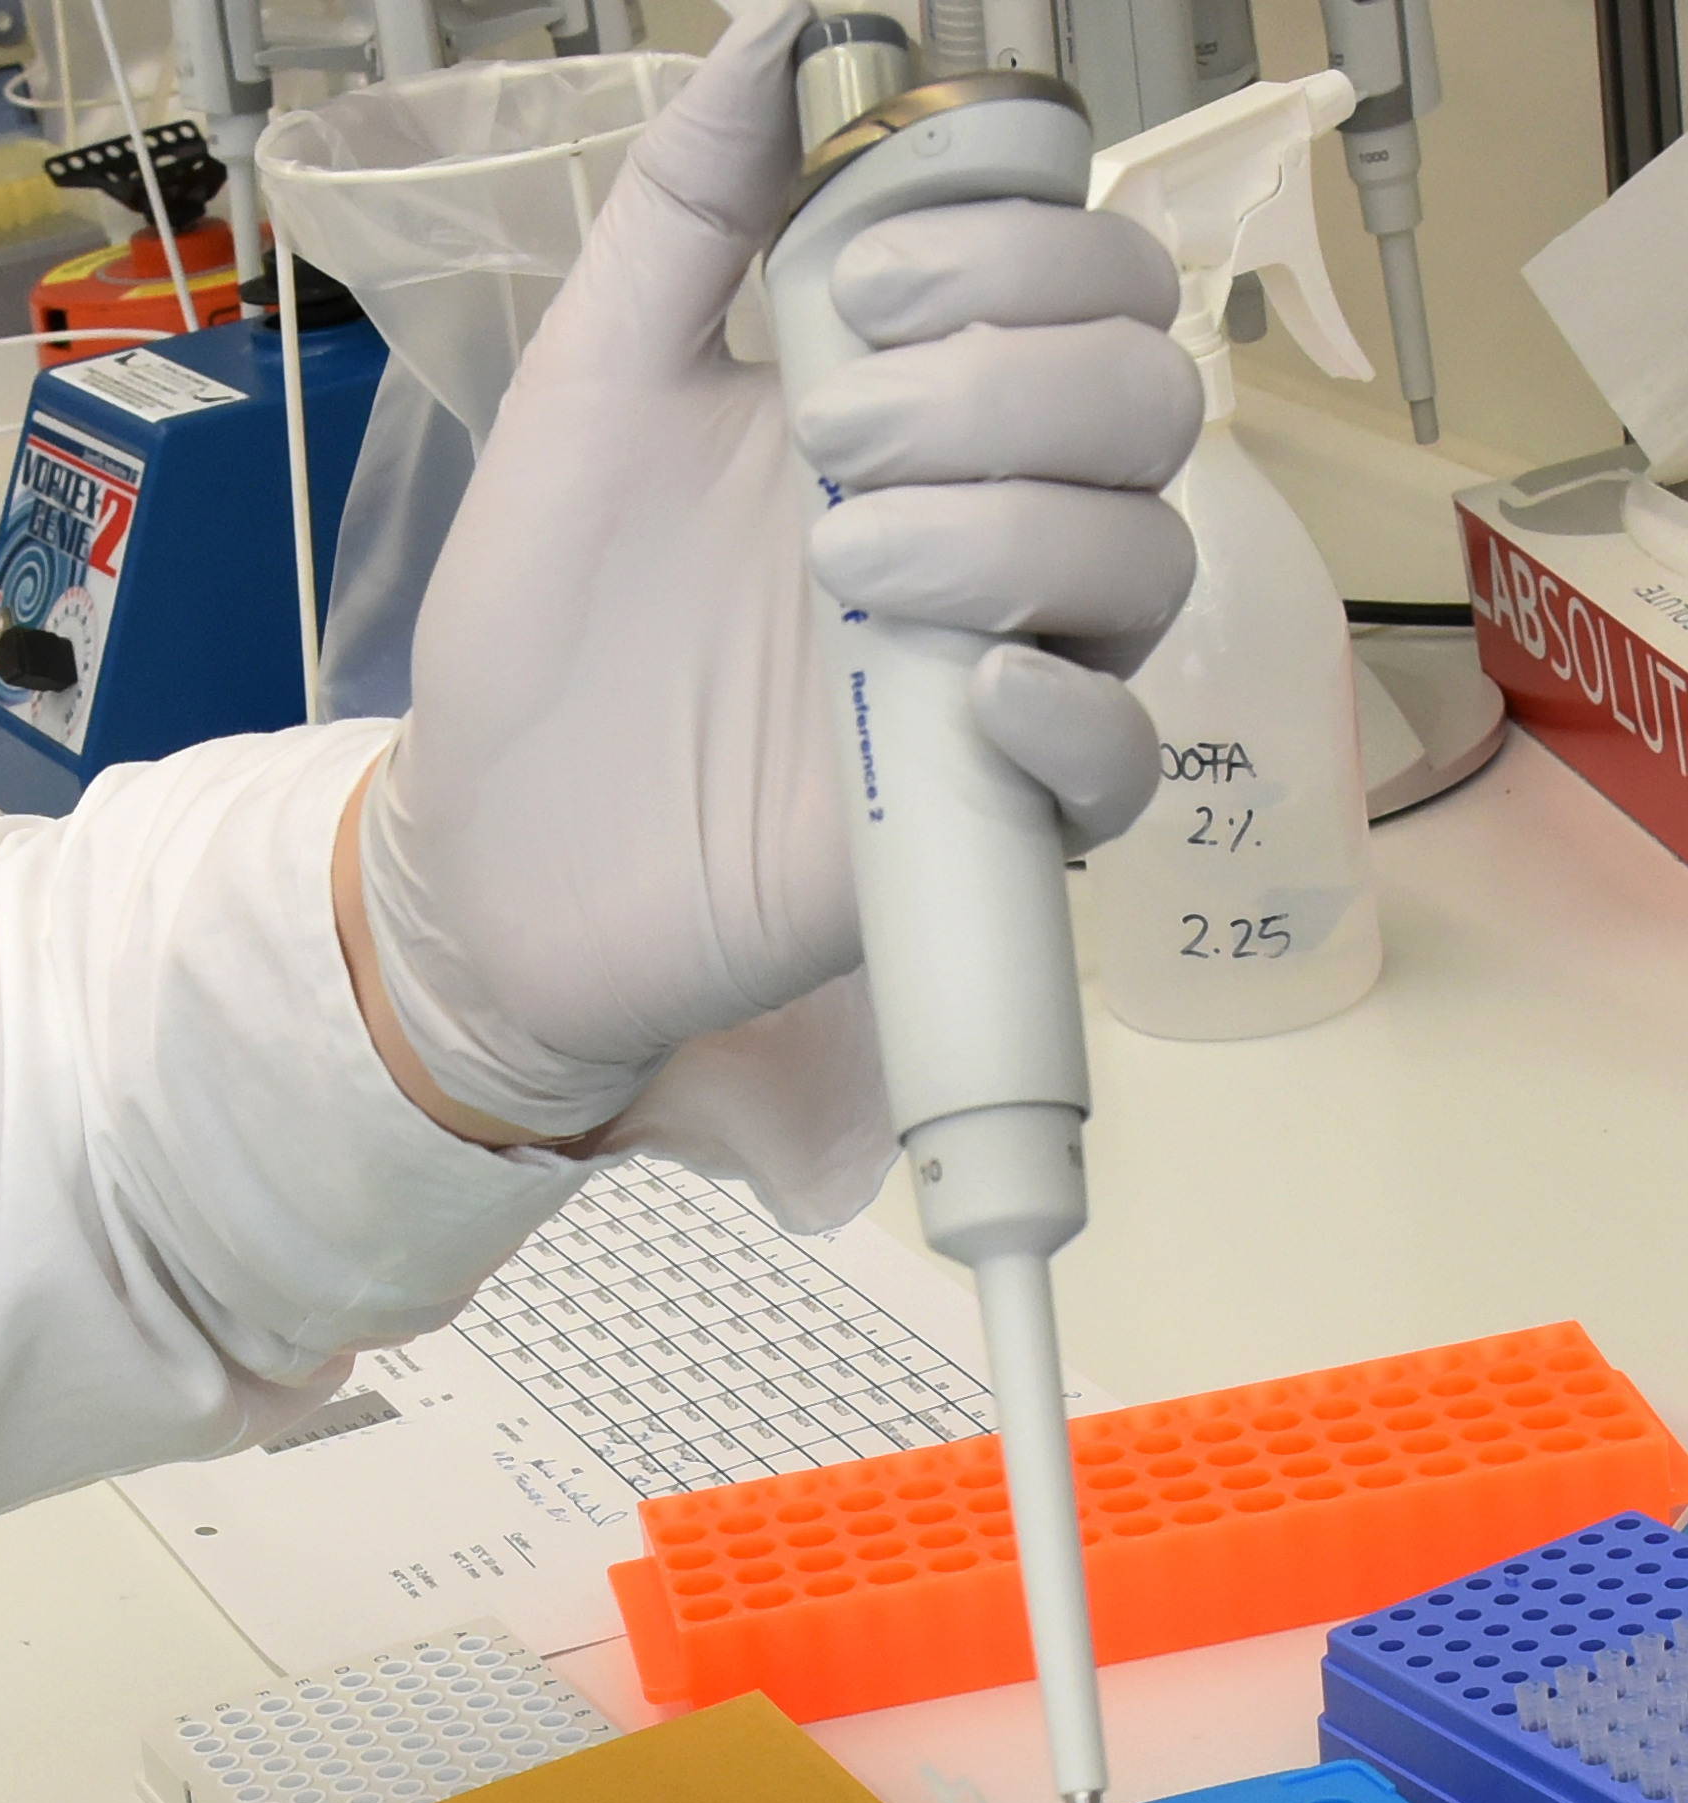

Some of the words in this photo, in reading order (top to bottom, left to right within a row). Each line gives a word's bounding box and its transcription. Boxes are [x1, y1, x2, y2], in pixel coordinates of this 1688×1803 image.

[1359, 150, 1389, 163] 1000
[28, 497, 93, 561] GENIE
[88, 489, 133, 578] 2
[850, 671, 879, 799] Reference
[869, 806, 885, 823] 2
[1180, 913, 1290, 959] 2.25
